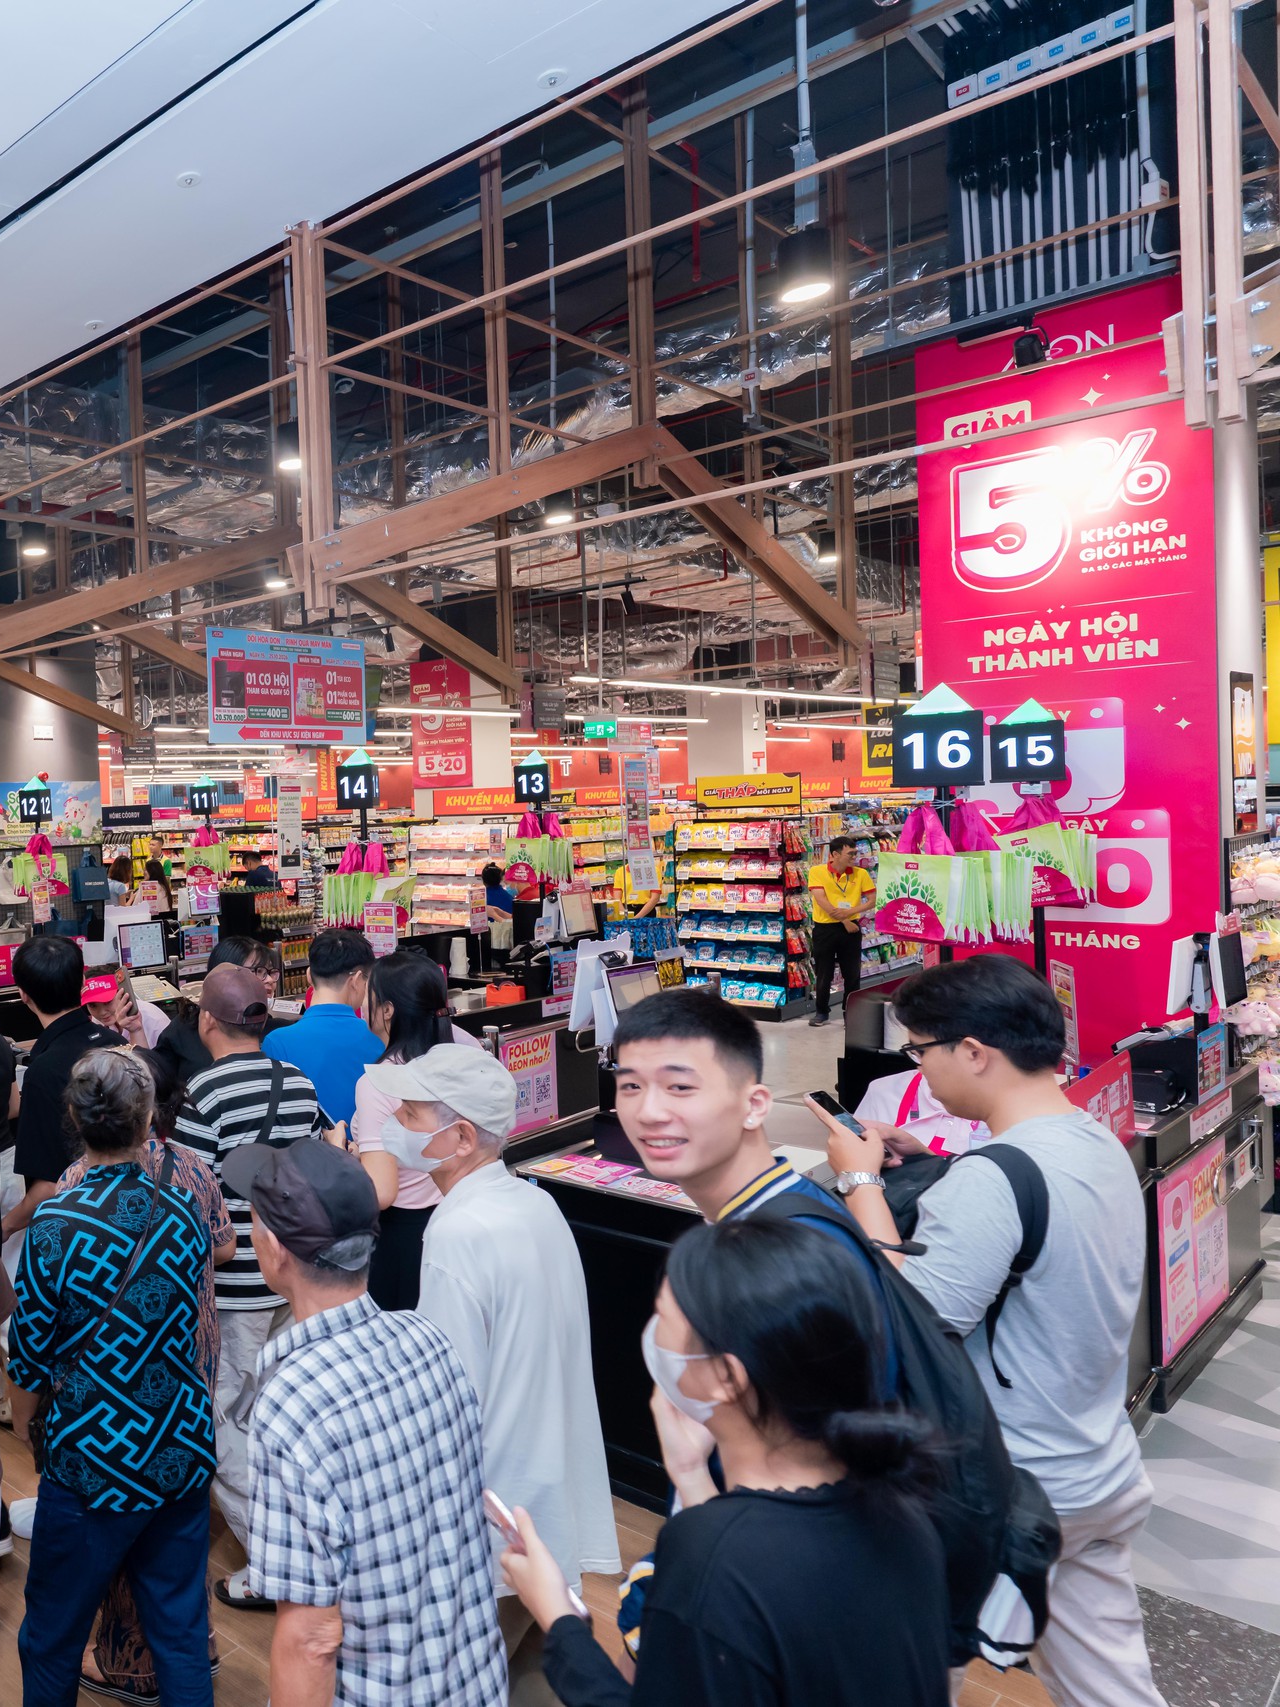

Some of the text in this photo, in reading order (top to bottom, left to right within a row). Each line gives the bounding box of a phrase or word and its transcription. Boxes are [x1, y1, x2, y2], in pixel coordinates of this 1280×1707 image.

[951, 411, 1027, 439] GIẢM
[950, 428, 1170, 592] 5%
[1081, 517, 1168, 544] KHÔNG
[1079, 534, 1187, 562] GIỚI HẠN
[1081, 566, 1095, 574] ĐA
[1096, 562, 1110, 573] SỐ
[1134, 557, 1156, 569] MẶT
[1158, 553, 1187, 564] HÀNG
[984, 611, 1138, 648] NGÀY HỘI
[968, 637, 1159, 674] THÀNH VIÊN
[246, 671, 289, 688] 01 CƠ HỘI
[326, 671, 337, 685] 01
[246, 687, 260, 695] THAM
[270, 689, 282, 697] QUAY
[415, 685, 430, 693] GIẢM
[326, 691, 337, 705] 01
[267, 708, 280, 718] 400
[342, 711, 355, 721] 600
[446, 716, 463, 725] KHÔNG
[270, 730, 282, 739] KHU
[312, 731, 325, 739] NGAY
[902, 730, 972, 770] 16
[998, 735, 1055, 768] 15
[320, 752, 328, 791] KHUYẾN
[426, 756, 435, 771] 5
[444, 758, 463, 772] 20
[340, 775, 368, 800] 14
[518, 773, 545, 796] 13
[705, 788, 717, 796] GIÁ
[717, 782, 757, 799] THẤP
[771, 785, 792, 794] NGÀY
[811, 782, 831, 793] MẠI
[860, 778, 893, 788] KHUYẾ
[193, 793, 208, 809] 11
[211, 791, 218, 807] 11
[446, 791, 515, 807] KHUYẾN MẠI
[562, 792, 575, 804] RẺ
[585, 789, 618, 800] KHUYẾN
[21, 797, 38, 816] 12
[40, 796, 51, 814] 12
[1068, 817, 1108, 832] GÀY
[1050, 930, 1140, 950] THÁNG
[509, 1033, 551, 1061] FOLLOW
[509, 1057, 528, 1072] AEON
